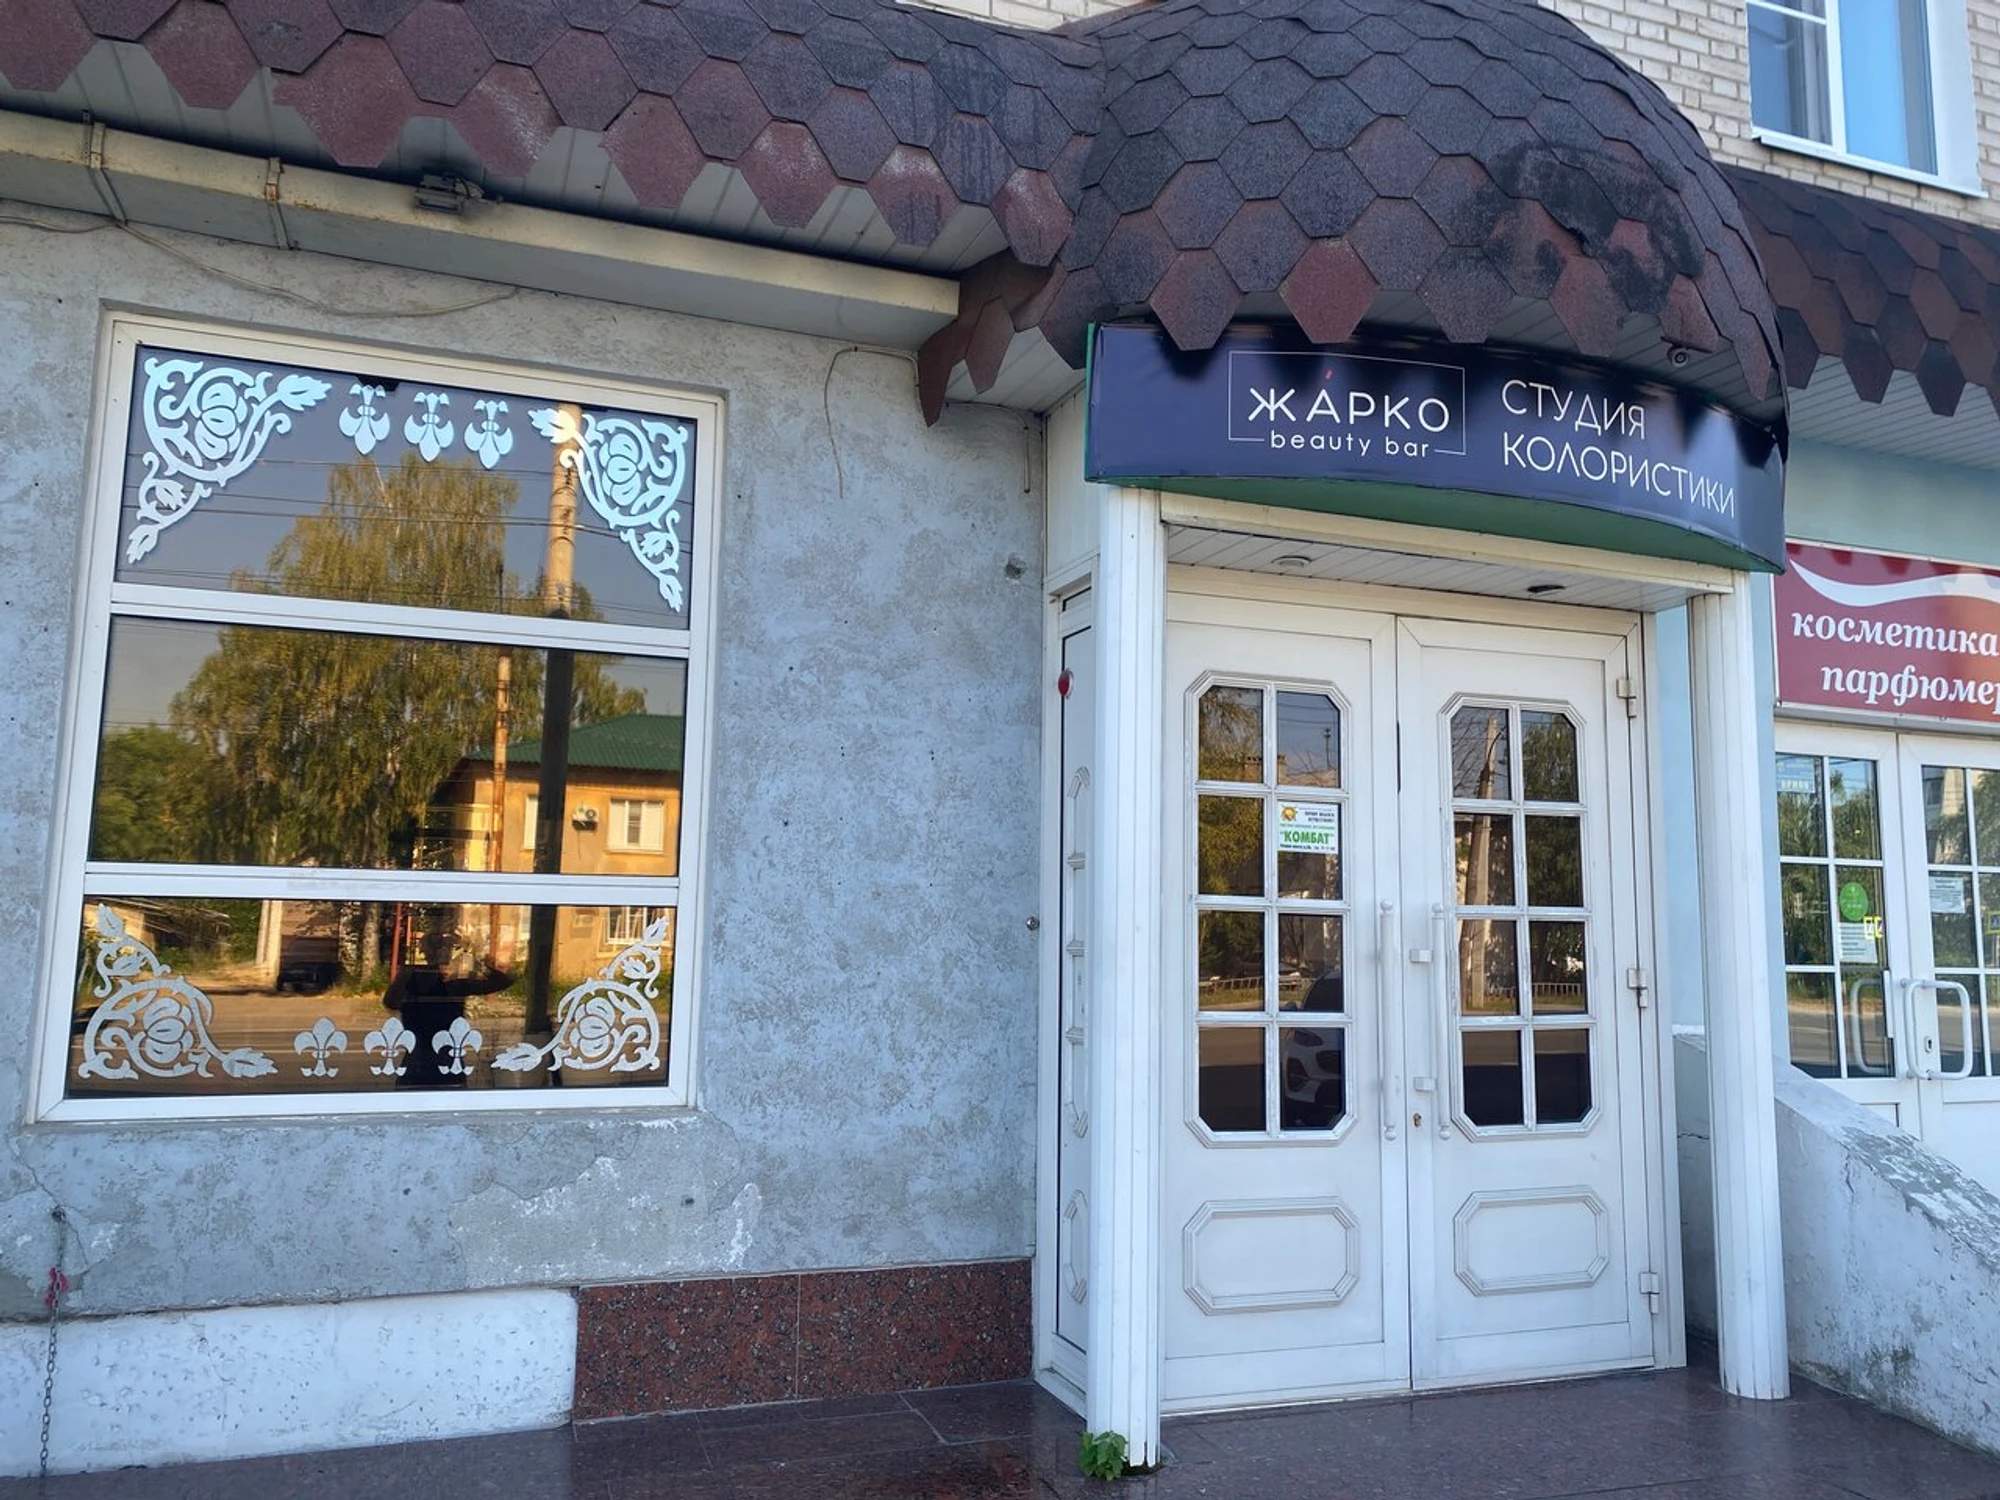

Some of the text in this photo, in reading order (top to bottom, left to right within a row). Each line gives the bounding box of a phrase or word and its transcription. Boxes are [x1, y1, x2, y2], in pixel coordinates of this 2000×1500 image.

[1248, 388, 1450, 432] ЖАРКО
[1502, 379, 1646, 440] СТУДИЯ
[1270, 430, 1430, 457] beauty bar
[1503, 431, 1735, 518] КОЛОРИСТИКИ
[1791, 612, 2000, 657] косметика
